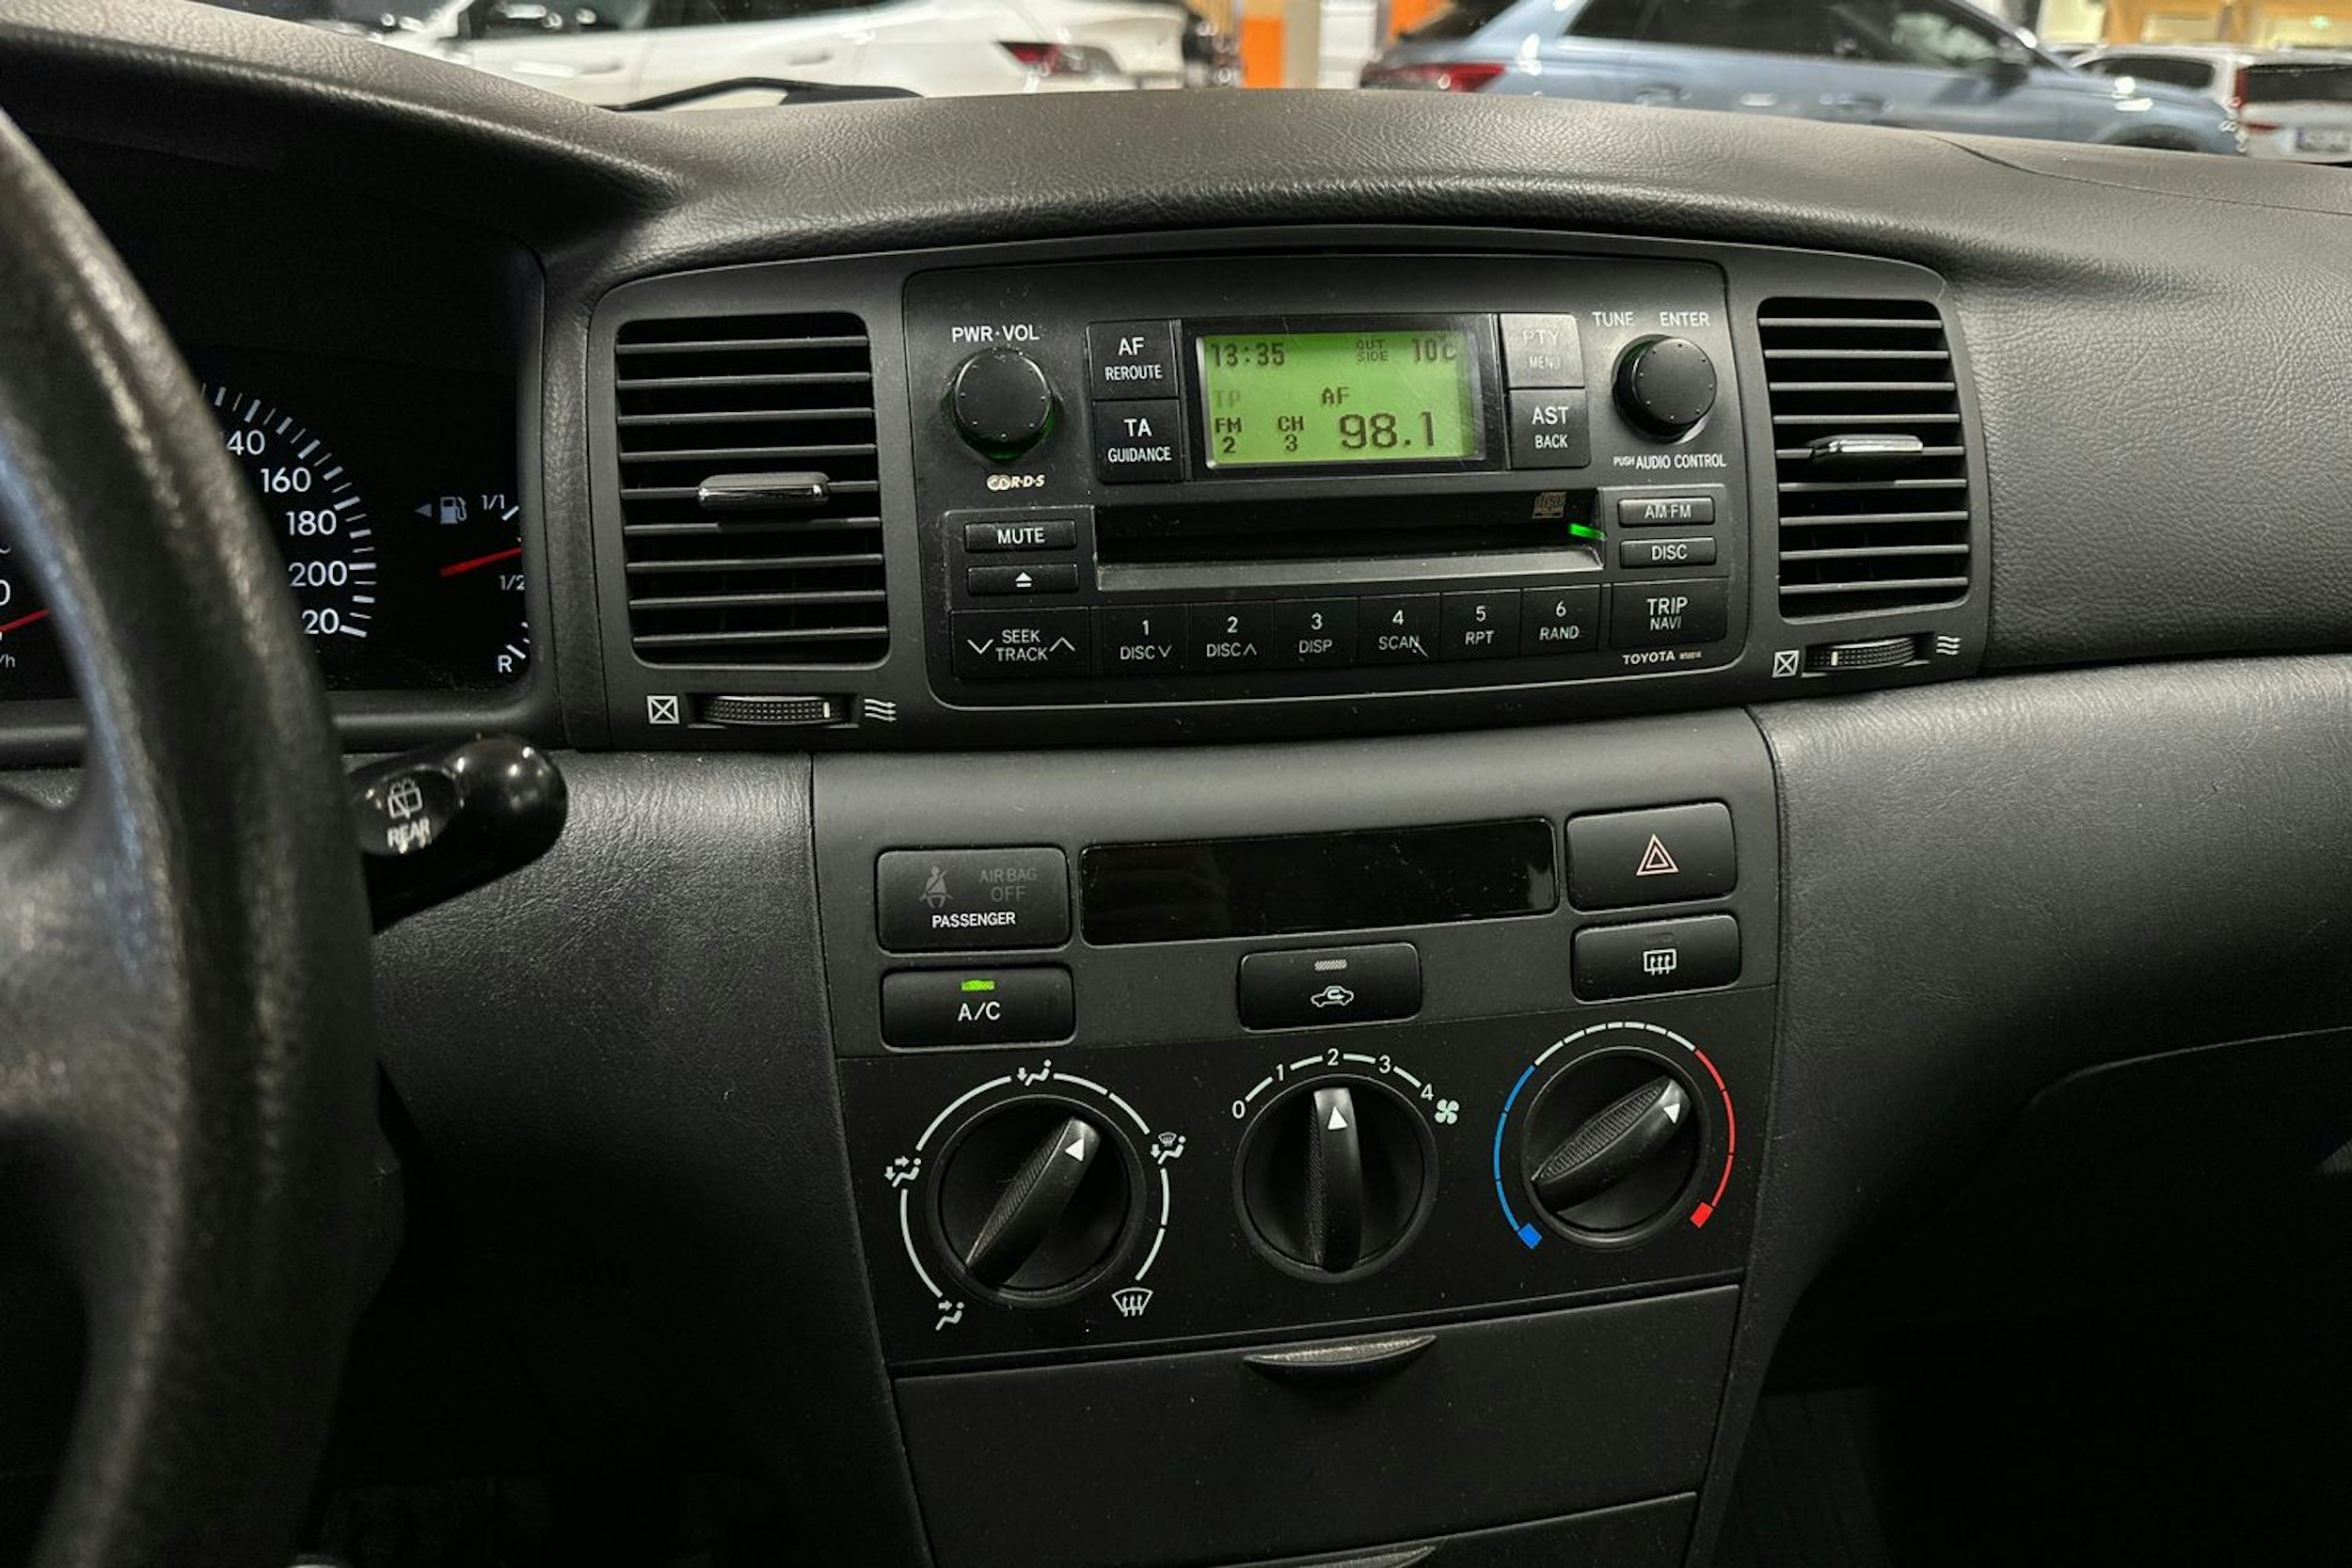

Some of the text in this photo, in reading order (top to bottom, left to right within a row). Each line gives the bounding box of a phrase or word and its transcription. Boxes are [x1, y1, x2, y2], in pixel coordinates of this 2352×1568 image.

[1592, 311, 1710, 326] TUNE ENTER
[1356, 339, 1384, 350] OUT
[1522, 329, 1560, 345] PTY
[1118, 336, 1144, 356] AF
[1210, 341, 1285, 367] 13:35
[1356, 351, 1389, 362] SIDE
[1104, 364, 1163, 380] REROUTE
[1215, 390, 1241, 408] TP
[1322, 387, 1350, 404] AF
[1278, 416, 1305, 432] CH
[1532, 406, 1569, 425] AST
[1124, 418, 1152, 437] TA
[1215, 417, 1243, 434] FM
[1339, 412, 1436, 451] 98.1
[219, 429, 265, 456] 40
[1222, 436, 1236, 454] 2
[1284, 435, 1298, 452] 3
[1534, 434, 1568, 449] BACK
[1107, 446, 1172, 463] GUIDANCE
[1613, 452, 1727, 470] PUSH AUDIO CONTROL
[260, 467, 312, 493] 160
[481, 494, 505, 511] 1/1
[285, 510, 338, 536] 180
[997, 527, 1045, 545] MUTE
[1651, 544, 1688, 561] DISC
[288, 561, 348, 587] 200
[499, 575, 525, 591] 1/2
[1475, 605, 1486, 623] 5
[1555, 600, 1567, 618] 6
[1646, 596, 1689, 615] TRIP
[301, 608, 340, 634] 20
[1227, 615, 1239, 634] 2
[1311, 612, 1323, 630] 3
[1392, 610, 1405, 626] 4
[1649, 615, 1682, 631] NAVI
[1001, 629, 1041, 644] SEEK
[1141, 619, 1150, 637] 1
[1538, 625, 1581, 641] RAND
[1378, 635, 1421, 651] SCAN
[1465, 630, 1495, 646] RPT
[995, 646, 1048, 662] TRACK
[1120, 644, 1156, 660] DISC
[1206, 641, 1243, 657] DISC
[1298, 639, 1333, 655] DISP
[497, 655, 513, 673] R
[1622, 650, 1677, 665] TOYOTA
[387, 816, 432, 850] REAR
[978, 866, 1038, 884] AIR BAG
[991, 885, 1026, 902] OFF
[931, 911, 1017, 929] PASSENGER
[957, 1001, 1001, 1022] A/C
[1231, 1048, 1435, 1119] 0 1 2 3 4
